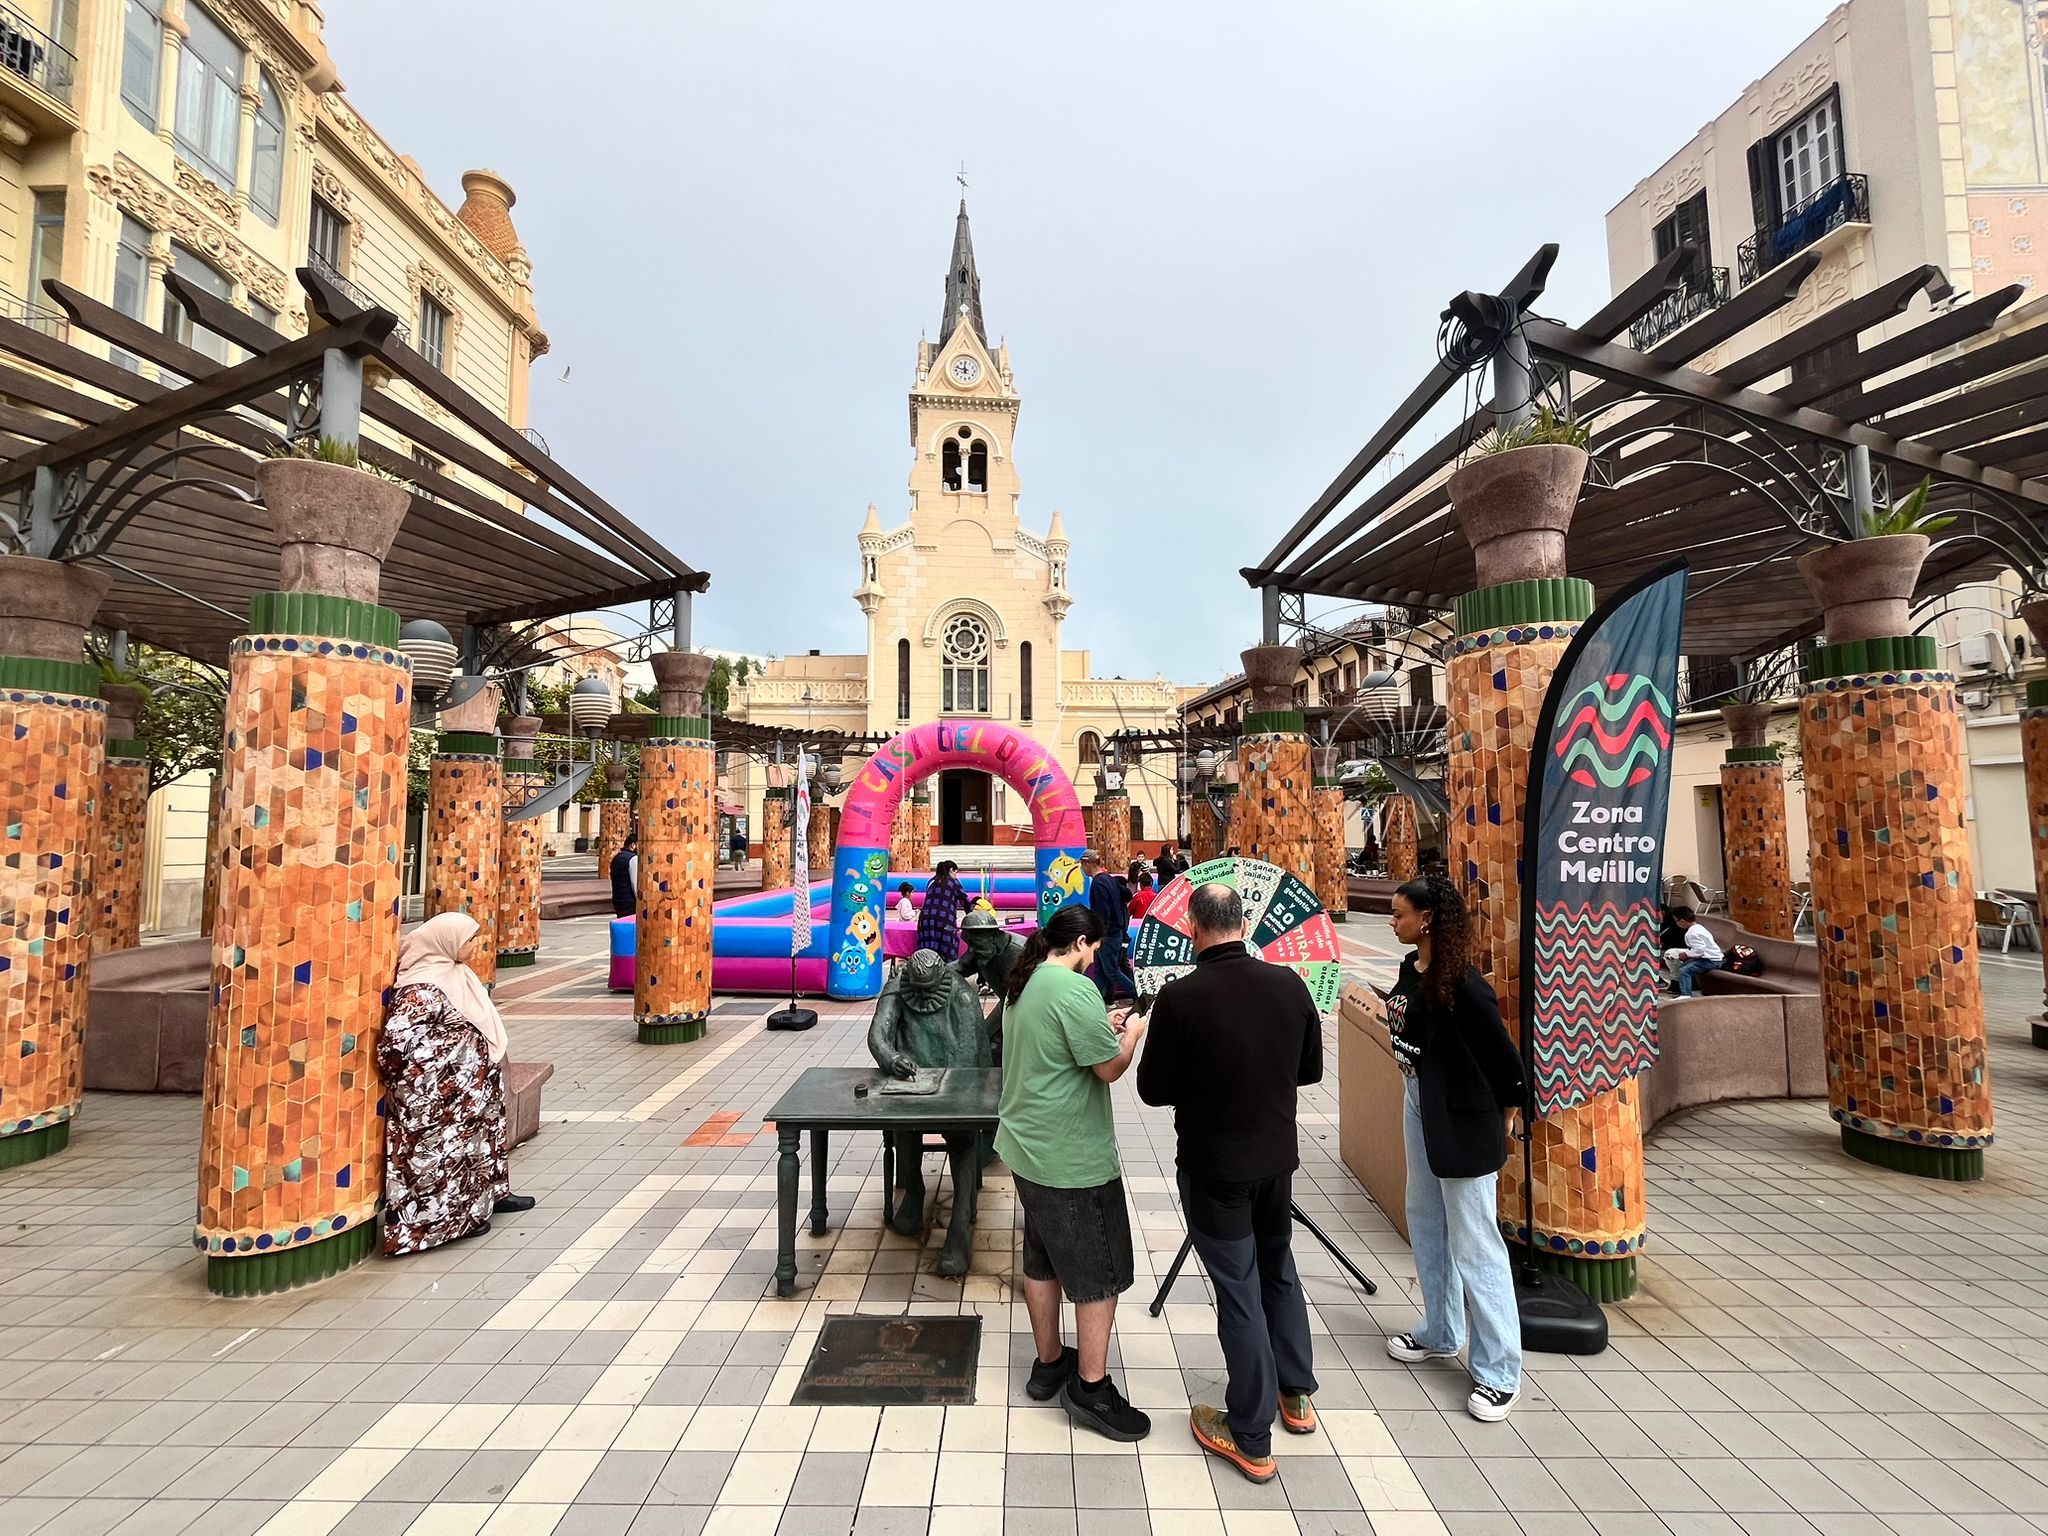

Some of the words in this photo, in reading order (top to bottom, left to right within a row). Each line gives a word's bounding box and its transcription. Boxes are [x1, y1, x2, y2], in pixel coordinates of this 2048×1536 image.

[861, 733, 930, 793] CASA
[937, 725, 987, 753] DEL
[1571, 801, 1643, 824] Zona
[1558, 830, 1656, 854] Centro
[1191, 868, 1235, 886] exclusividad
[1203, 861, 1228, 875] ganas
[1241, 859, 1252, 867] Tú
[1252, 862, 1278, 874] ganas
[1244, 870, 1272, 882] calidad
[1560, 860, 1651, 884] Melilla
[1150, 894, 1171, 915] Melilla
[1170, 879, 1186, 898] gana
[1160, 887, 1189, 918] identidad
[1242, 888, 1262, 902] 10
[1283, 888, 1311, 913] garantía
[1289, 877, 1299, 889] Tú
[1297, 887, 1319, 908] ganas
[1265, 913, 1286, 932] puntos
[1273, 902, 1295, 925] 50
[1136, 949, 1144, 961] Tú
[1140, 923, 1151, 949] ganas
[1146, 923, 1160, 965] confianza
[1164, 935, 1180, 961] 30
[1276, 940, 1286, 958] vez
[1284, 936, 1295, 957] otra
[1292, 925, 1311, 963] TIRA
[1314, 930, 1324, 949] vida
[1326, 940, 1338, 960] gana
[1315, 966, 1327, 1002] atención
[1330, 968, 1338, 978] Tú
[1324, 978, 1335, 1005] ganas
[1212, 1434, 1236, 1453] HOKA
